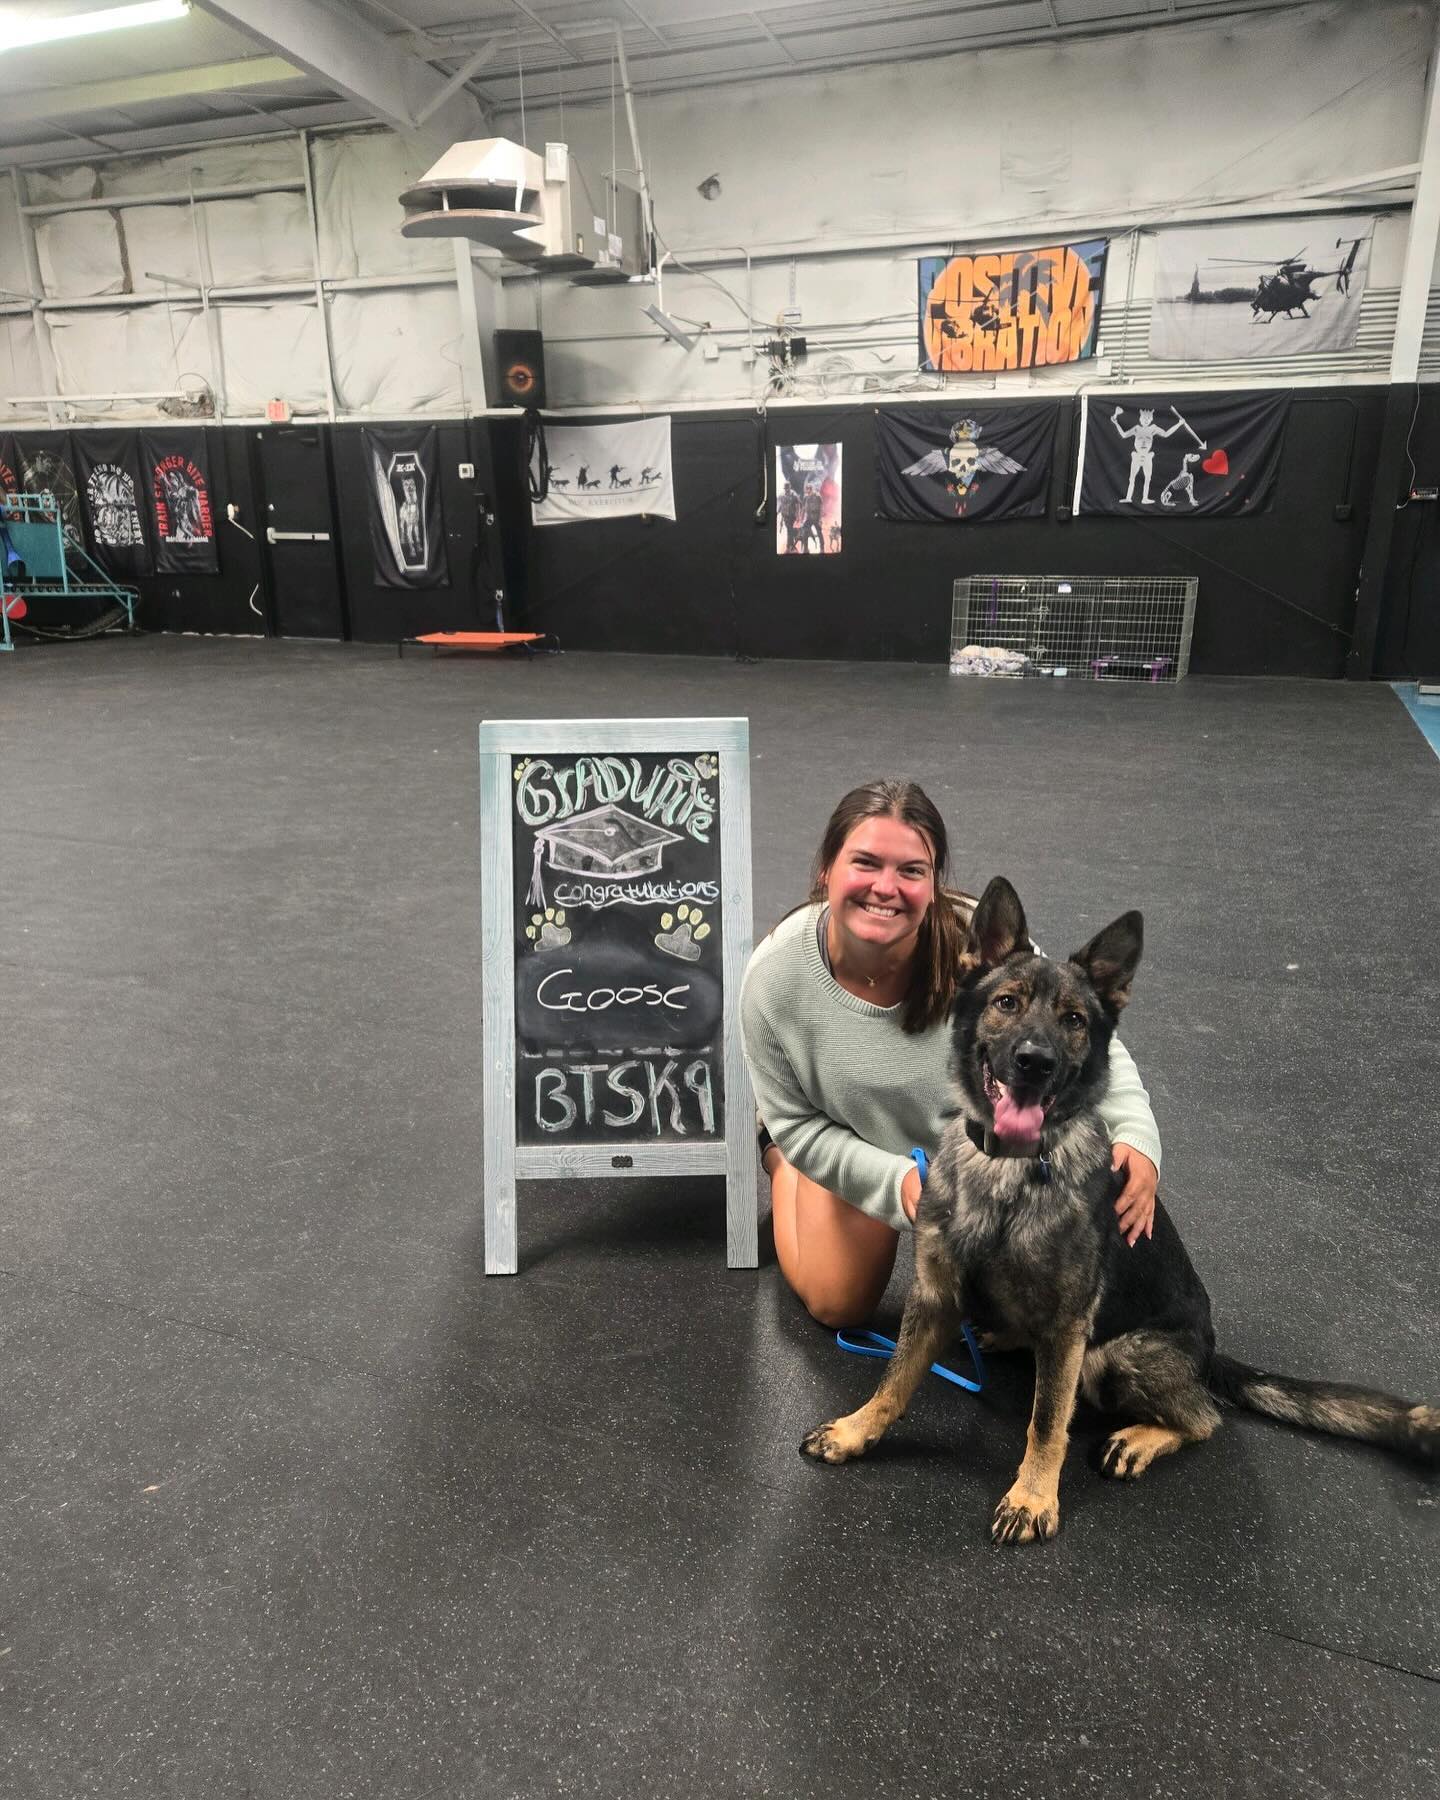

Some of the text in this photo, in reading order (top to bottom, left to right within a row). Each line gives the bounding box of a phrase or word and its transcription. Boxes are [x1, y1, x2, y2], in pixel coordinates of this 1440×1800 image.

[155, 502, 169, 537] TRAIN
[186, 461, 206, 486] BITE
[200, 490, 213, 537] HARDER
[535, 1060, 715, 1136] BTSK9
